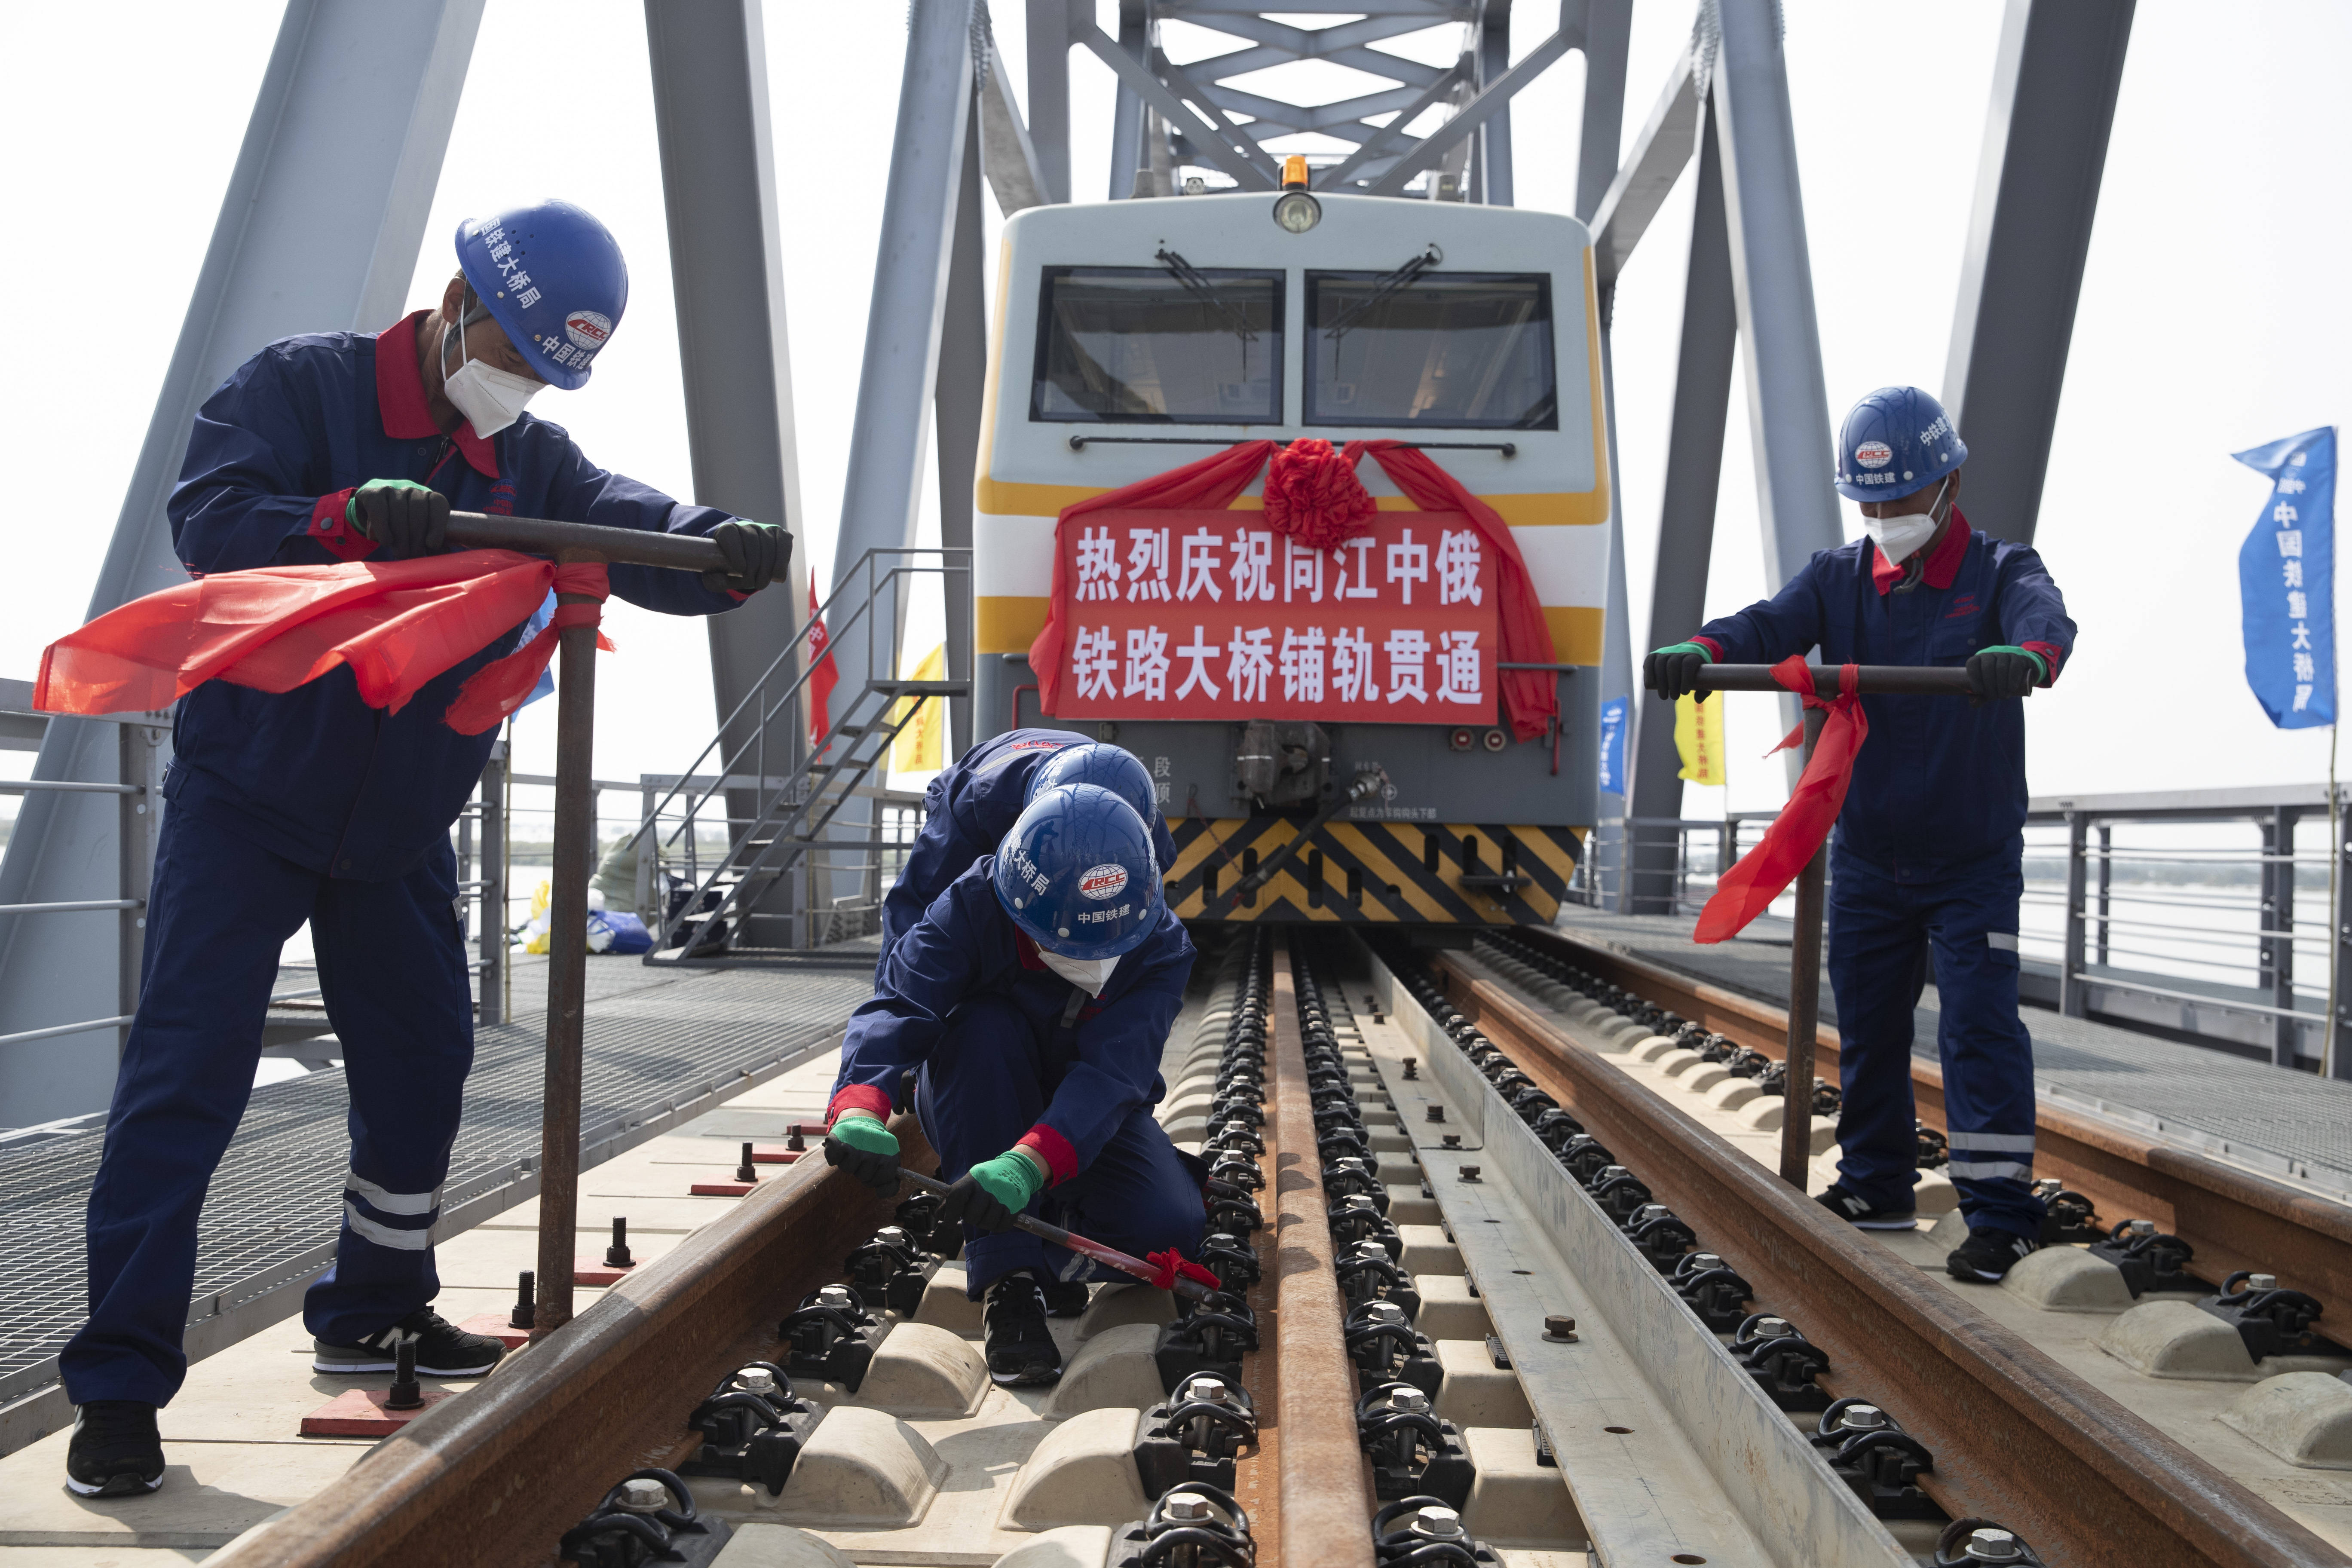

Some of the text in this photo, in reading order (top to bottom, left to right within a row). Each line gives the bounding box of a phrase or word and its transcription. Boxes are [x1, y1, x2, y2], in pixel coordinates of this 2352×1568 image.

[480, 217, 542, 309] 国铁建大桥局
[567, 319, 611, 341] CRCC
[1856, 472, 1896, 485] 中国铁建
[1075, 526, 1482, 606] 热烈庆祝同江中俄
[1072, 625, 1483, 704] 铁路大桥铺轨贯通
[1082, 873, 1125, 890] CRCC
[1078, 903, 1130, 924] 中国铁建
